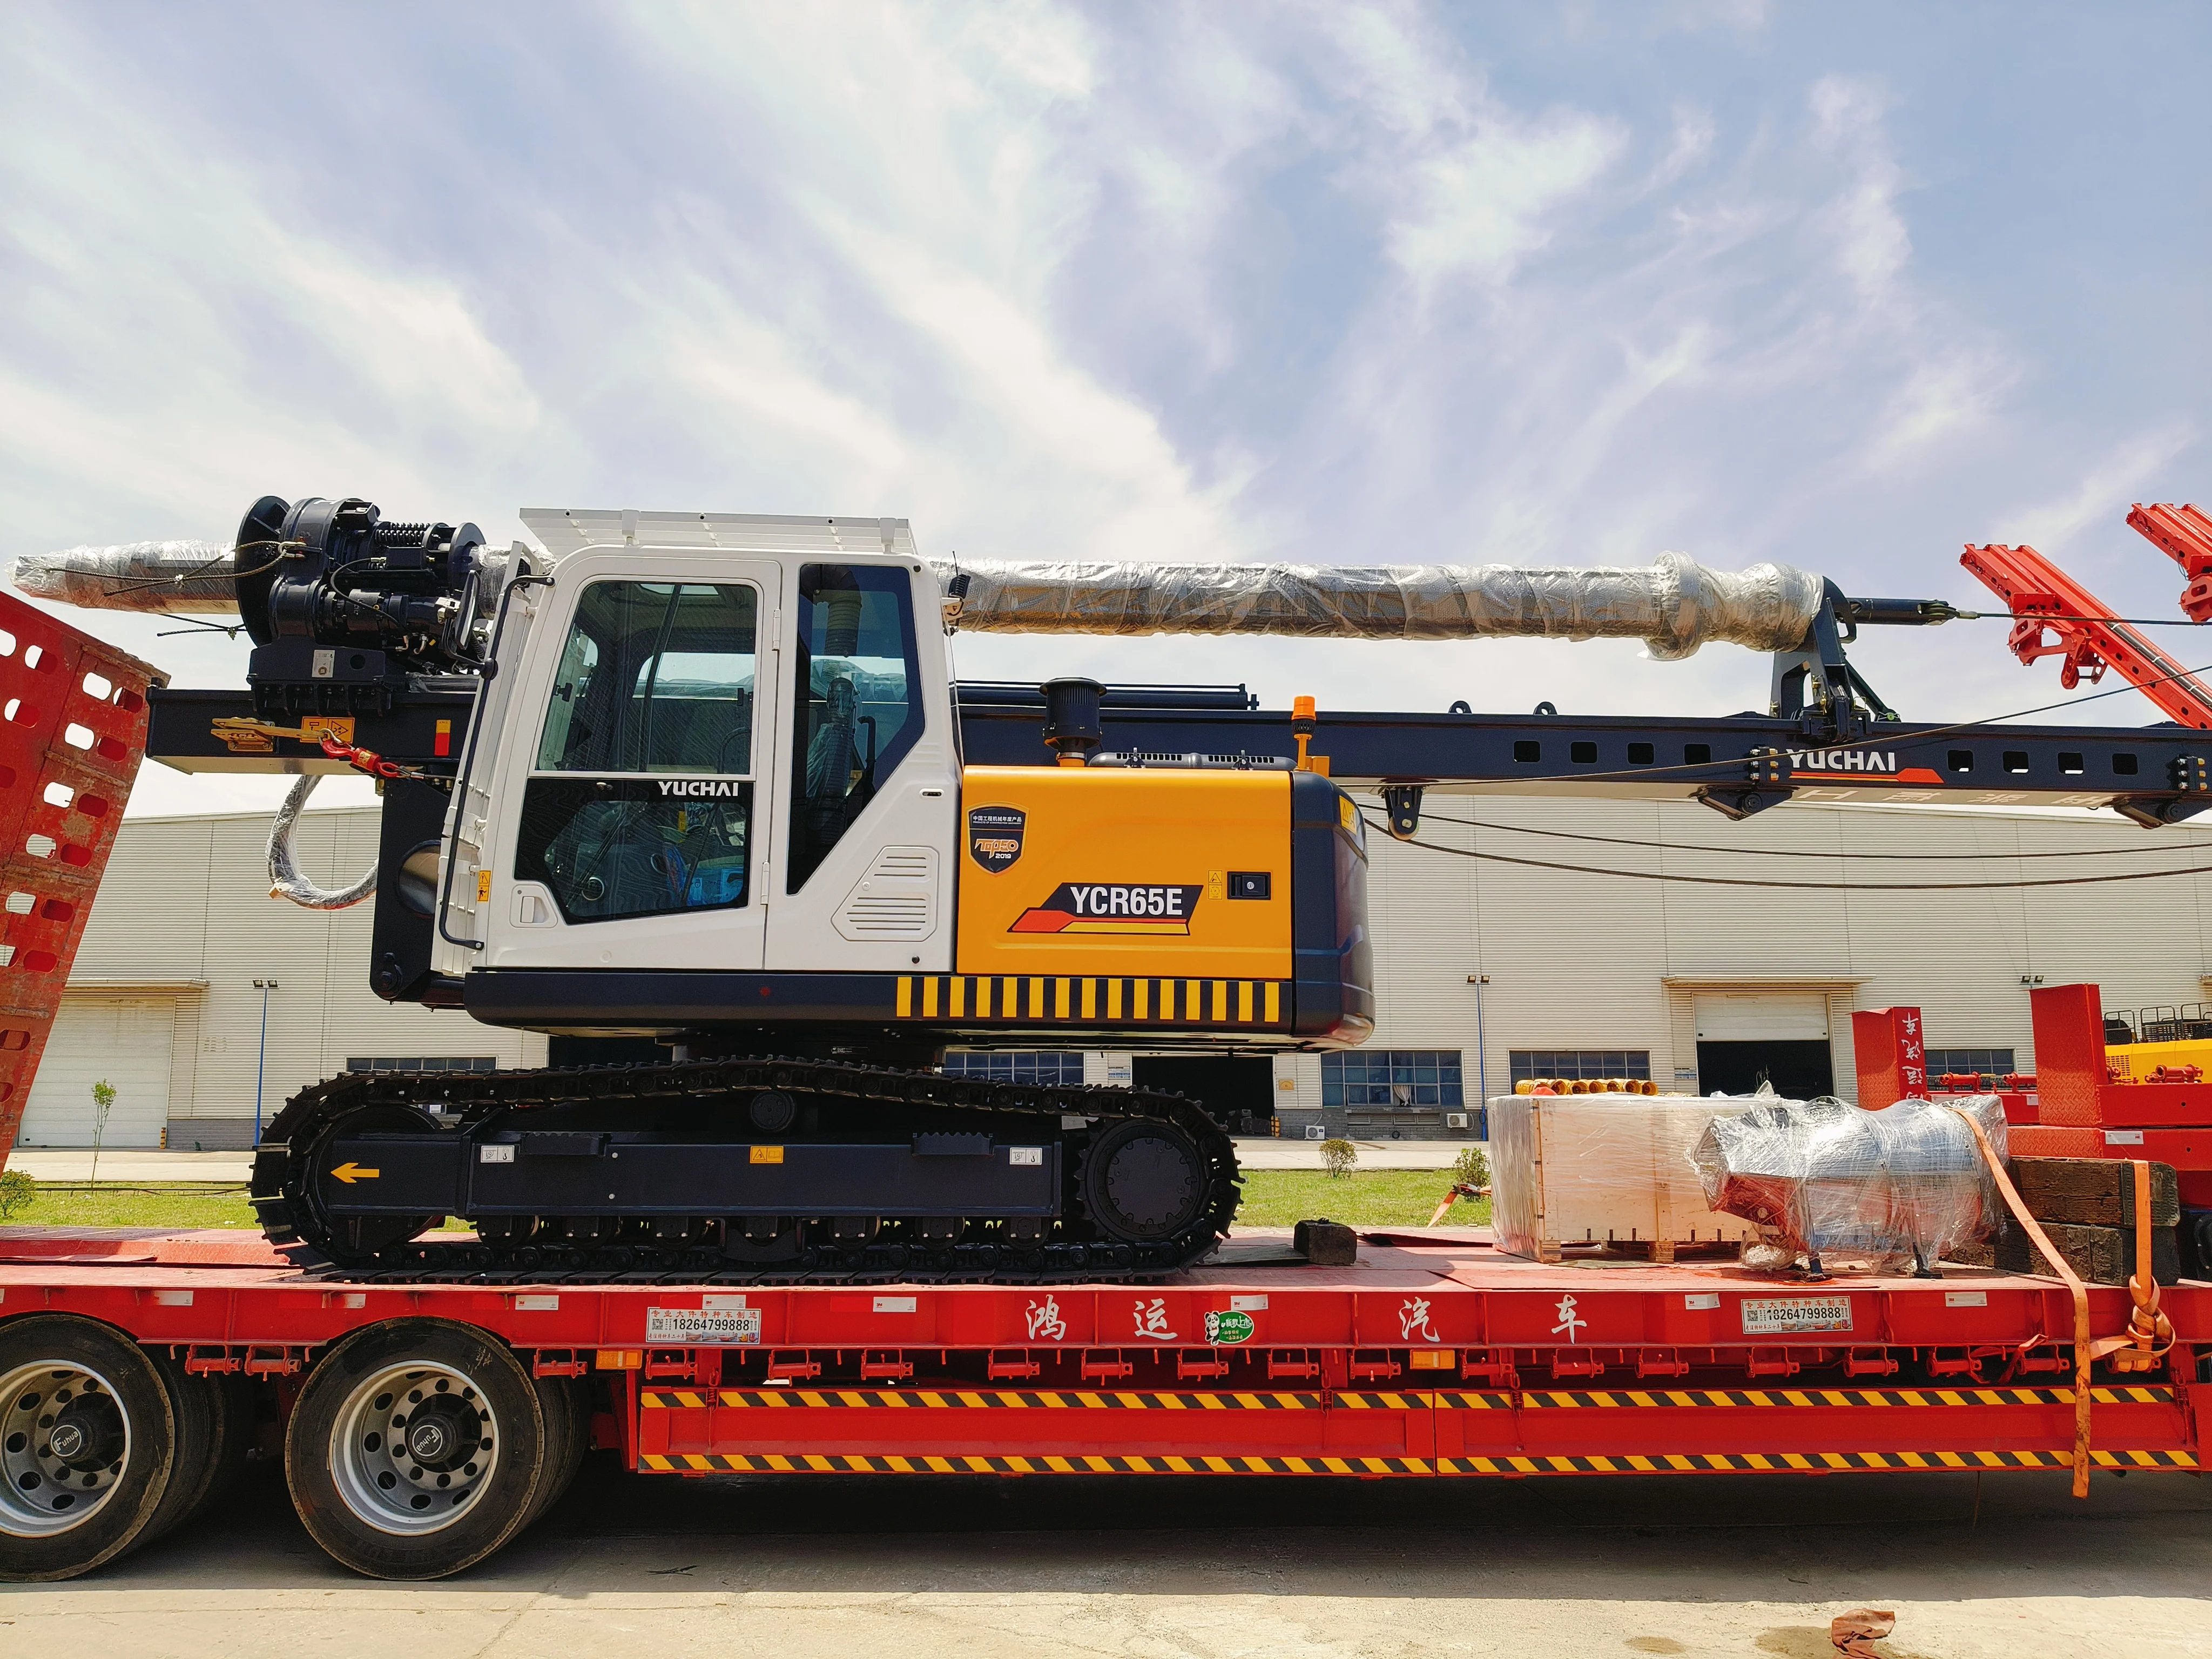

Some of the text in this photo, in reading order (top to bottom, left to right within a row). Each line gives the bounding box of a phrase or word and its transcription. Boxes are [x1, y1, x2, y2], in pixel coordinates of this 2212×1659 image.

[1786, 748, 1896, 771] YUCHAI
[658, 781, 739, 797] YUCHAI
[1070, 886, 1183, 915] YCR65E
[651, 1310, 757, 1319] 专业大件特种车制造
[1766, 1307, 1841, 1320] 18264799888
[673, 1319, 749, 1331] 18264799888
[53, 1431, 79, 1452] Fuhua
[416, 1428, 440, 1452] Fuhua
